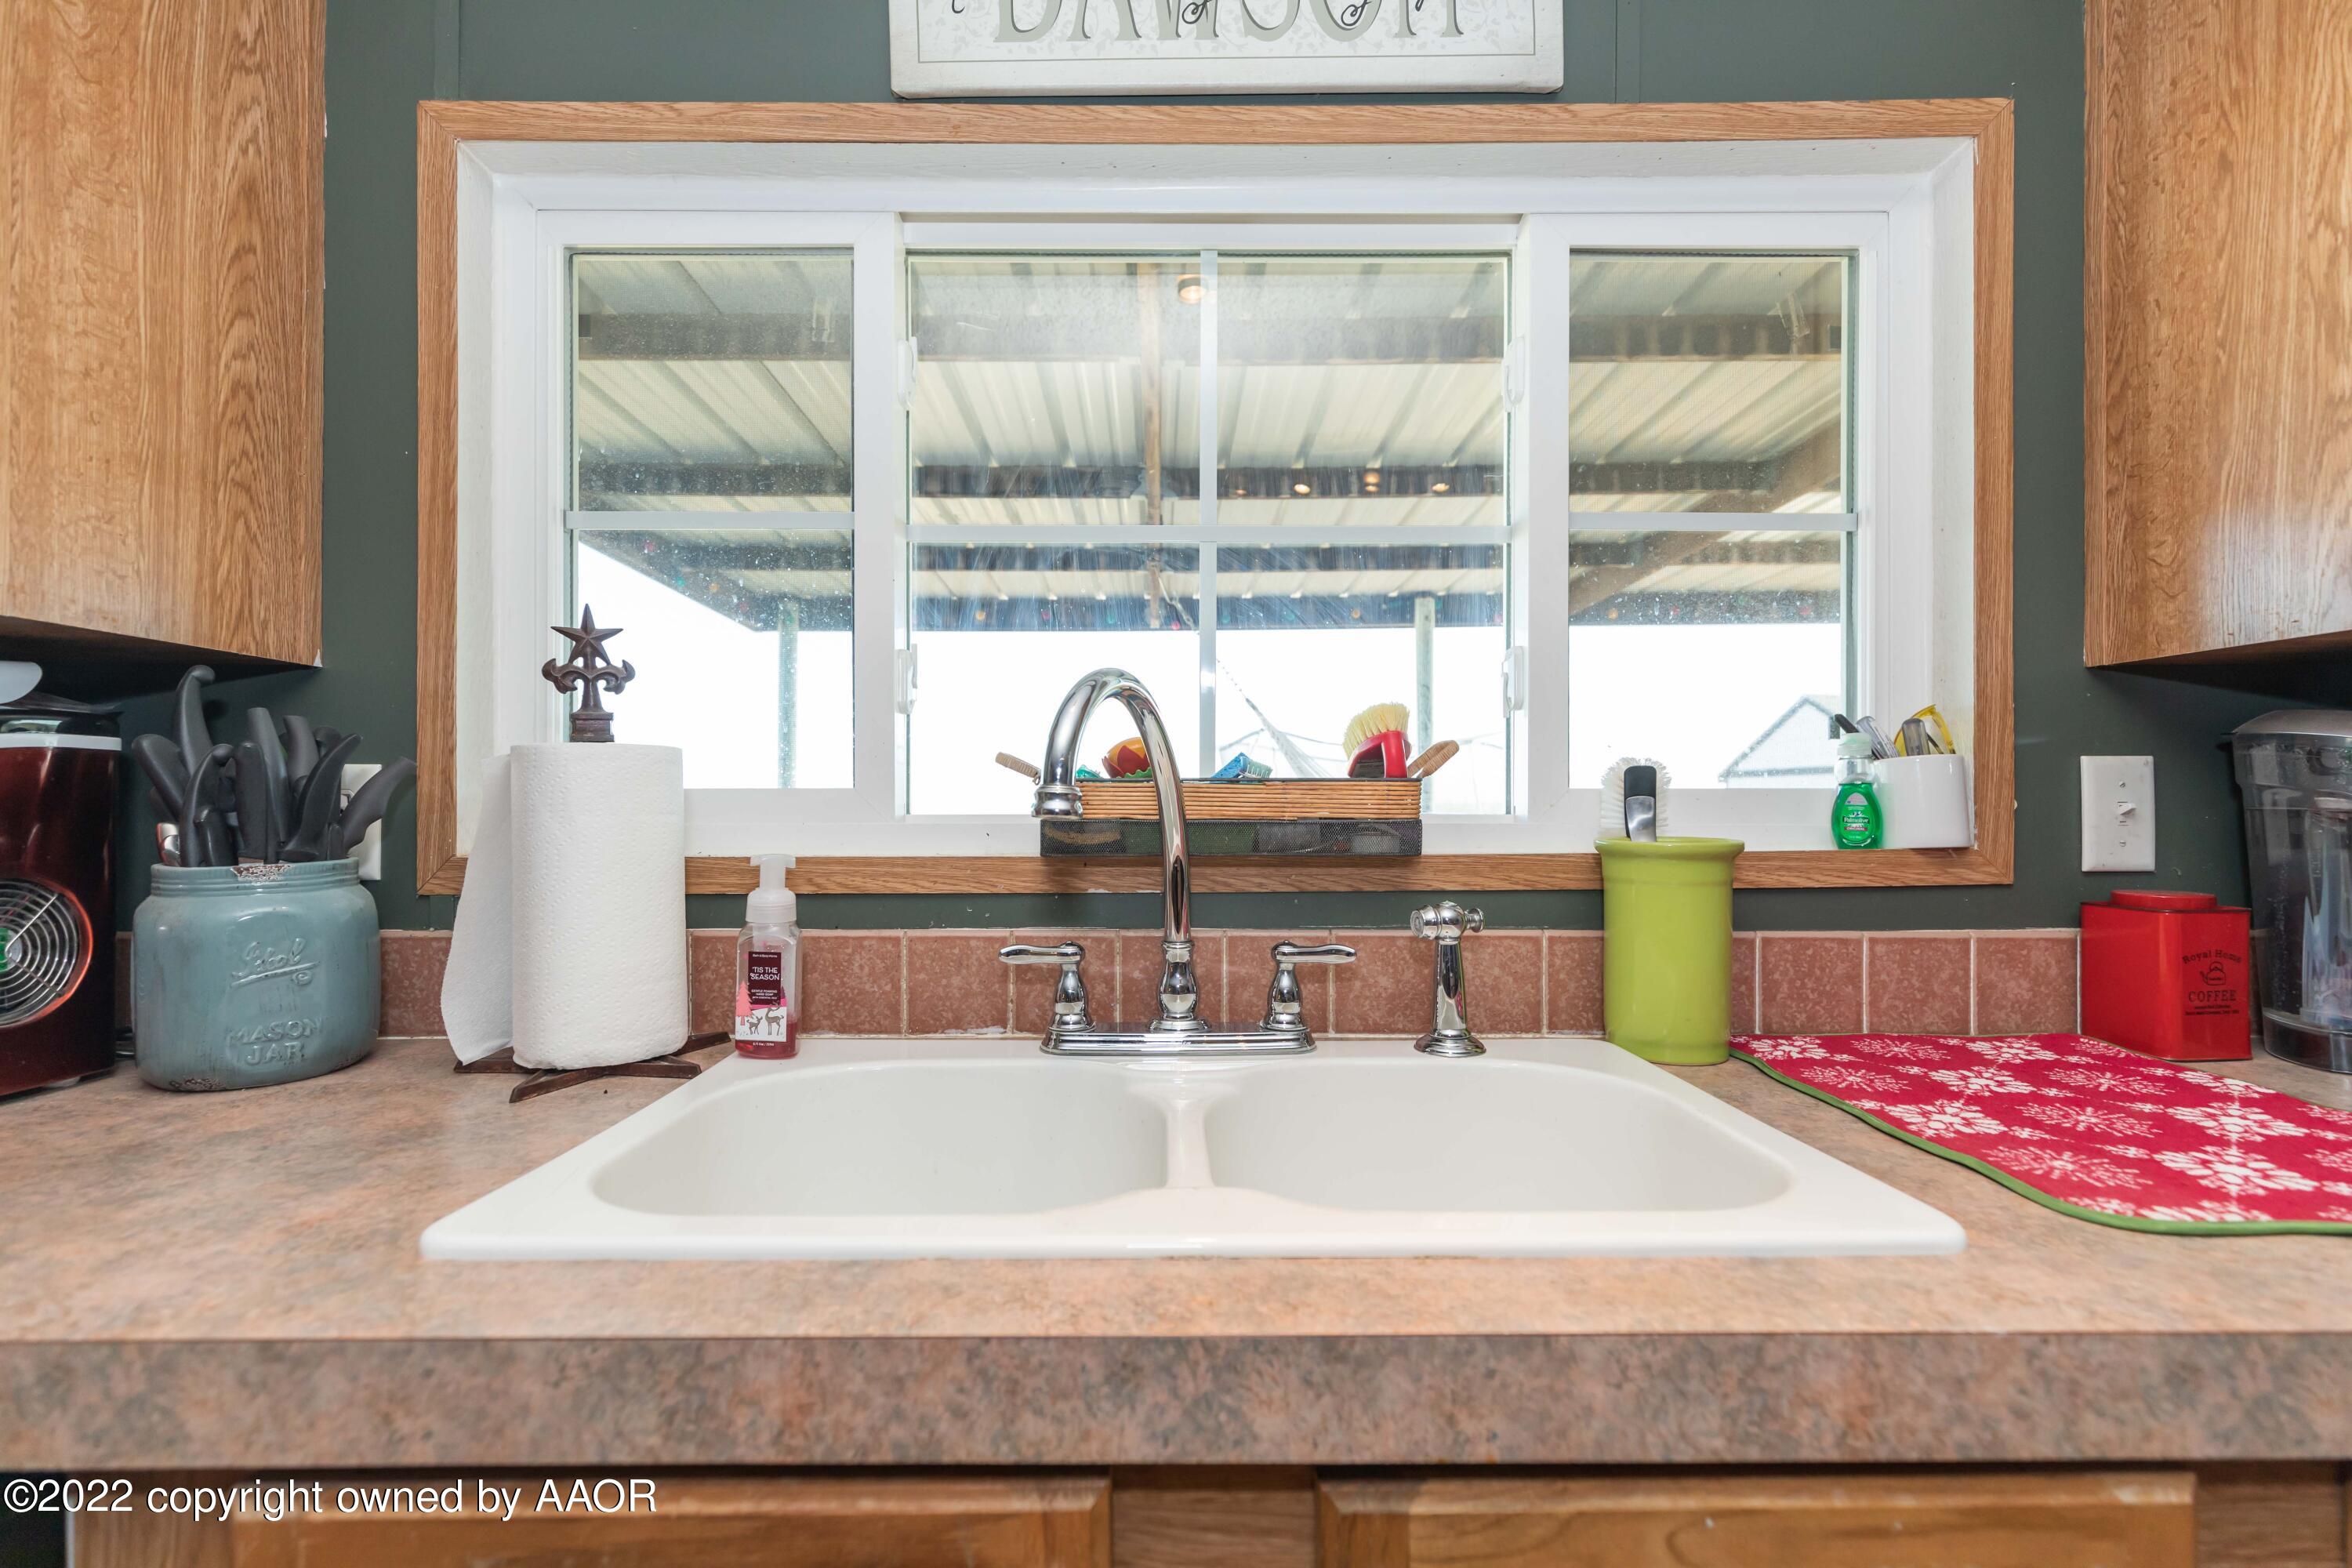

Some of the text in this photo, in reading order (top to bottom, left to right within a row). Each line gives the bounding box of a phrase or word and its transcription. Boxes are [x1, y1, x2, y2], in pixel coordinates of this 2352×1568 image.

[2183, 949, 2241, 964] Royal Home
[750, 972, 780, 981] SEASON
[2188, 989, 2237, 1003] COFFEE
[226, 1018, 322, 1044] MASON
[246, 1042, 303, 1065] JAR
